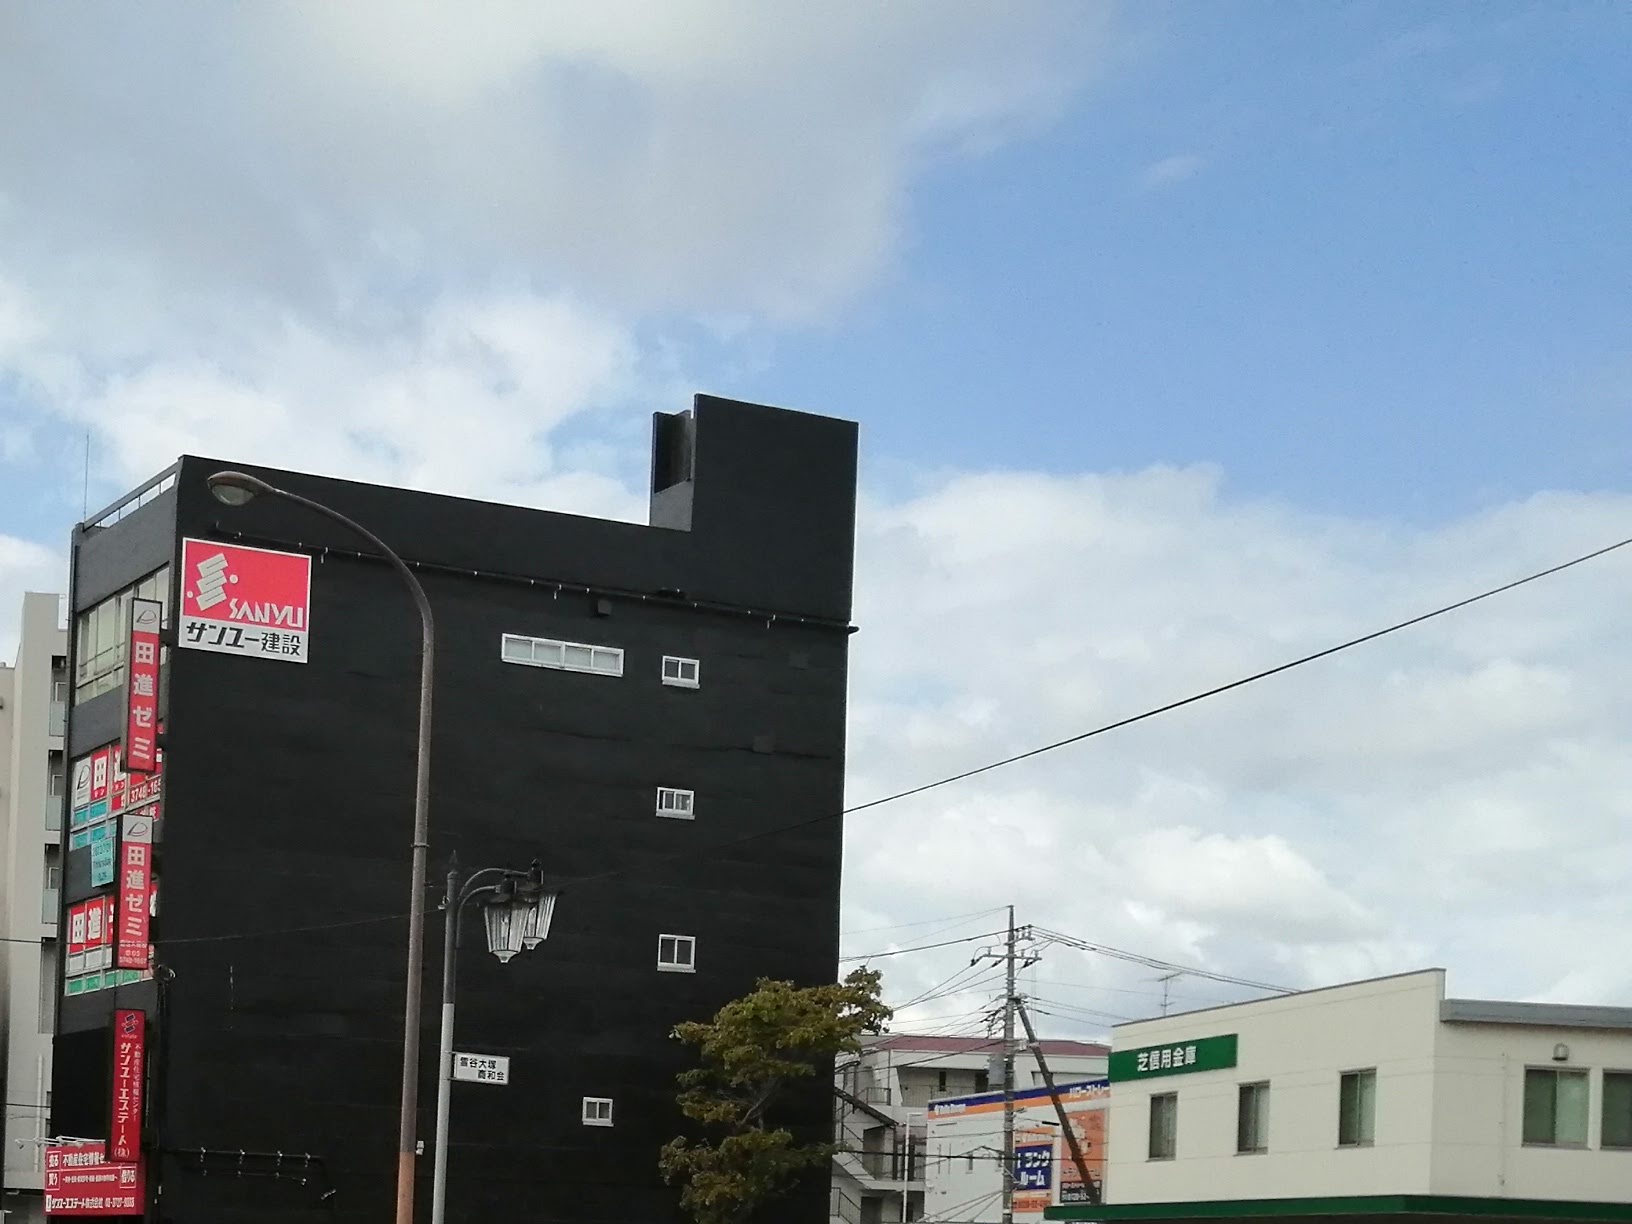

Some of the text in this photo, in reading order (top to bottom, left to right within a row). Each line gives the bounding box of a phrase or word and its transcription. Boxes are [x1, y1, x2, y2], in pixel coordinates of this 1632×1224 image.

[229, 598, 304, 628] SANYU
[186, 622, 302, 656] サンユー建設
[132, 641, 155, 760] 田進ゼミ
[125, 845, 146, 937] 田進ゼミ
[460, 1056, 497, 1070] 雪谷大塚
[1137, 1045, 1197, 1072] 芝信用金庫
[478, 1070, 505, 1081] 商和会
[114, 1042, 132, 1158] サンユーエステート(株)
[1020, 1169, 1046, 1187] ルーム
